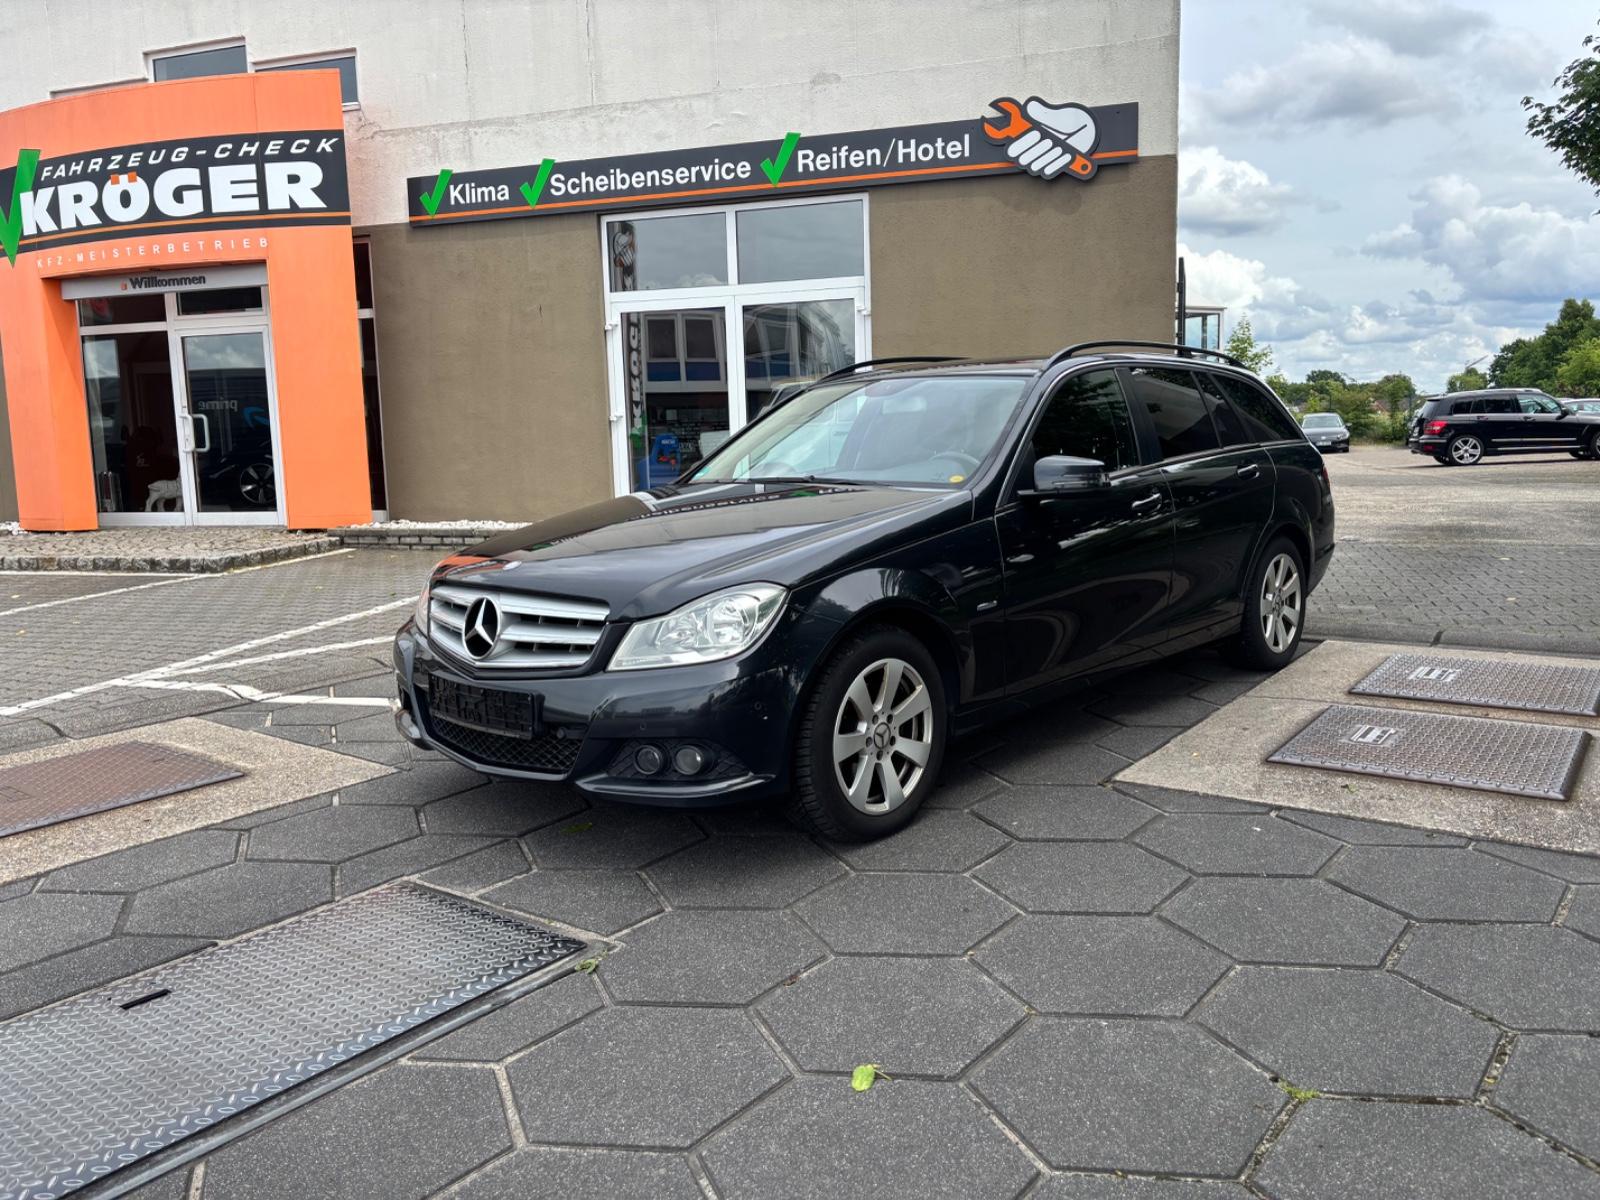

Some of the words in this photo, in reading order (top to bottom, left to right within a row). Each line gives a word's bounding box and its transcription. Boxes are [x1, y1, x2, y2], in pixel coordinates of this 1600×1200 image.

[41, 138, 339, 181] FAHRZEUG-CHECK
[450, 183, 509, 205] Klima
[550, 158, 751, 196] Scheibenservice
[20, 161, 327, 235] KRÖGER
[129, 275, 206, 290] Willkommen
